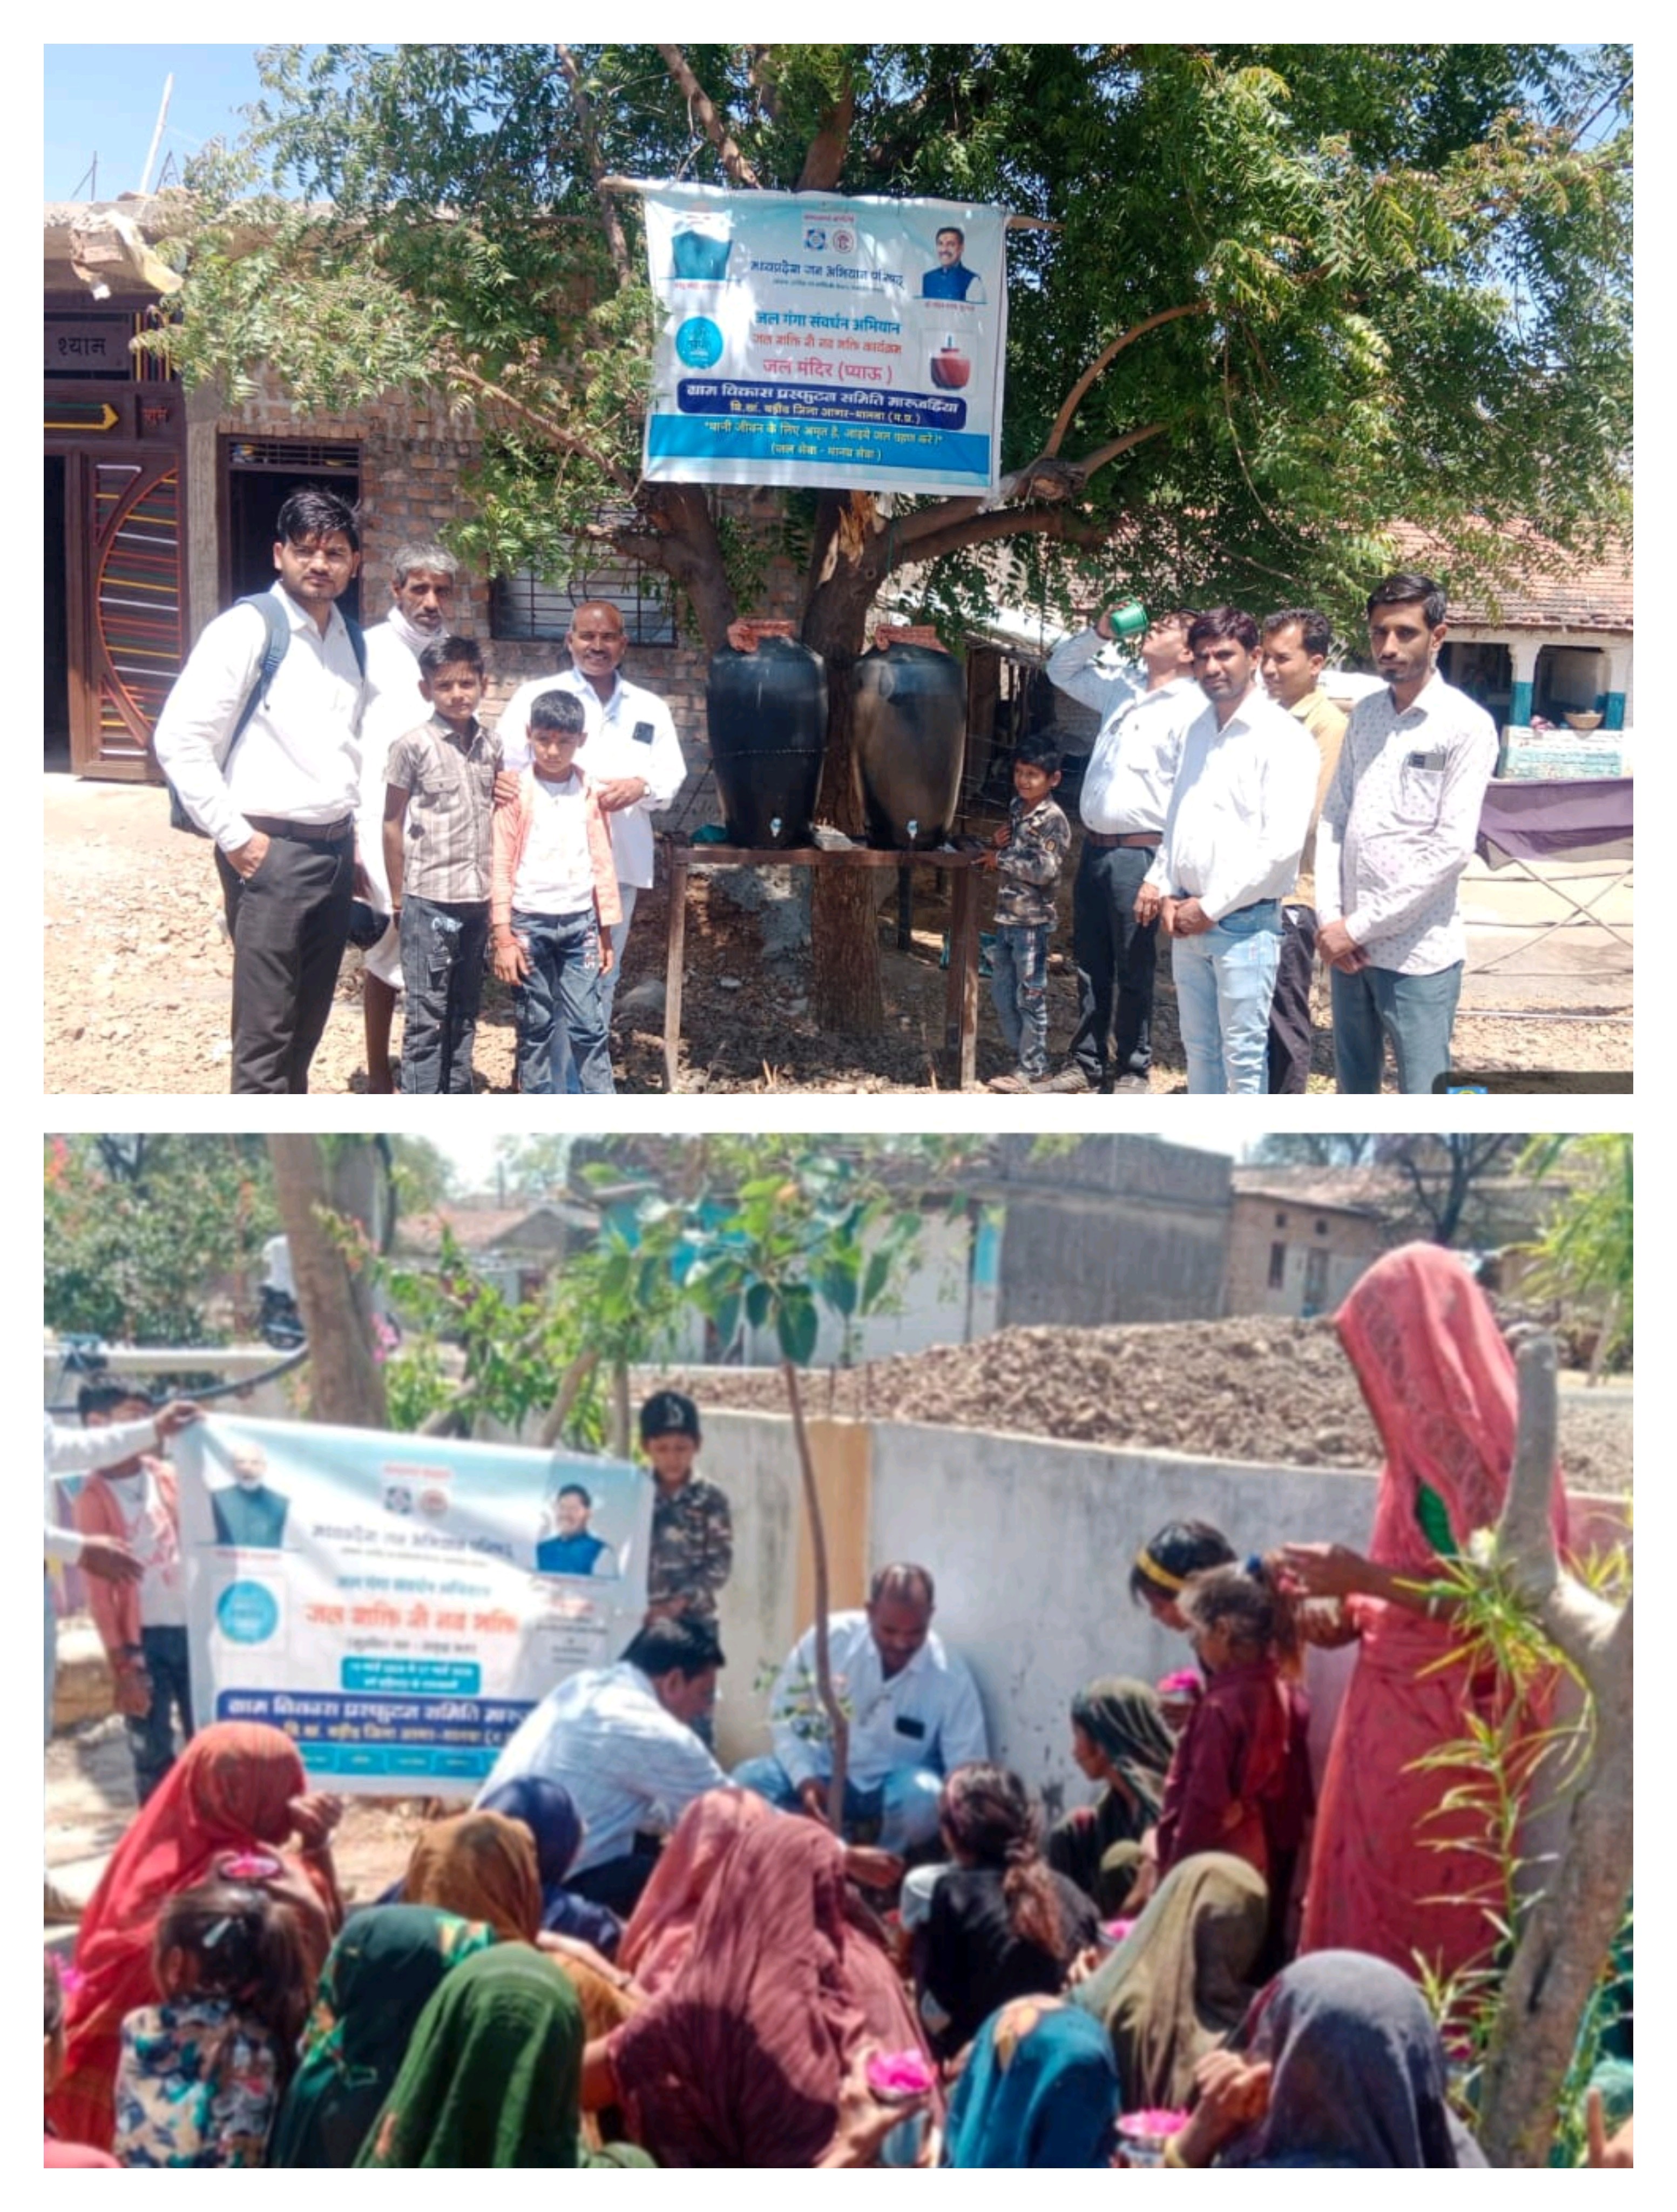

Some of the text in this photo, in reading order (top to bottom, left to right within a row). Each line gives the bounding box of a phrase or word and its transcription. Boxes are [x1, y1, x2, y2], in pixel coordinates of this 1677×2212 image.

[756, 311, 901, 334] जल गंगा संवर्धन अभियान
[763, 359, 792, 375] जल
[797, 356, 833, 377] मंदिर
[687, 384, 718, 396] ग्राम
[721, 382, 773, 399] विकास
[777, 388, 836, 404] प्रस्फुटन
[840, 390, 884, 406] समिति
[781, 421, 800, 436] लिए
